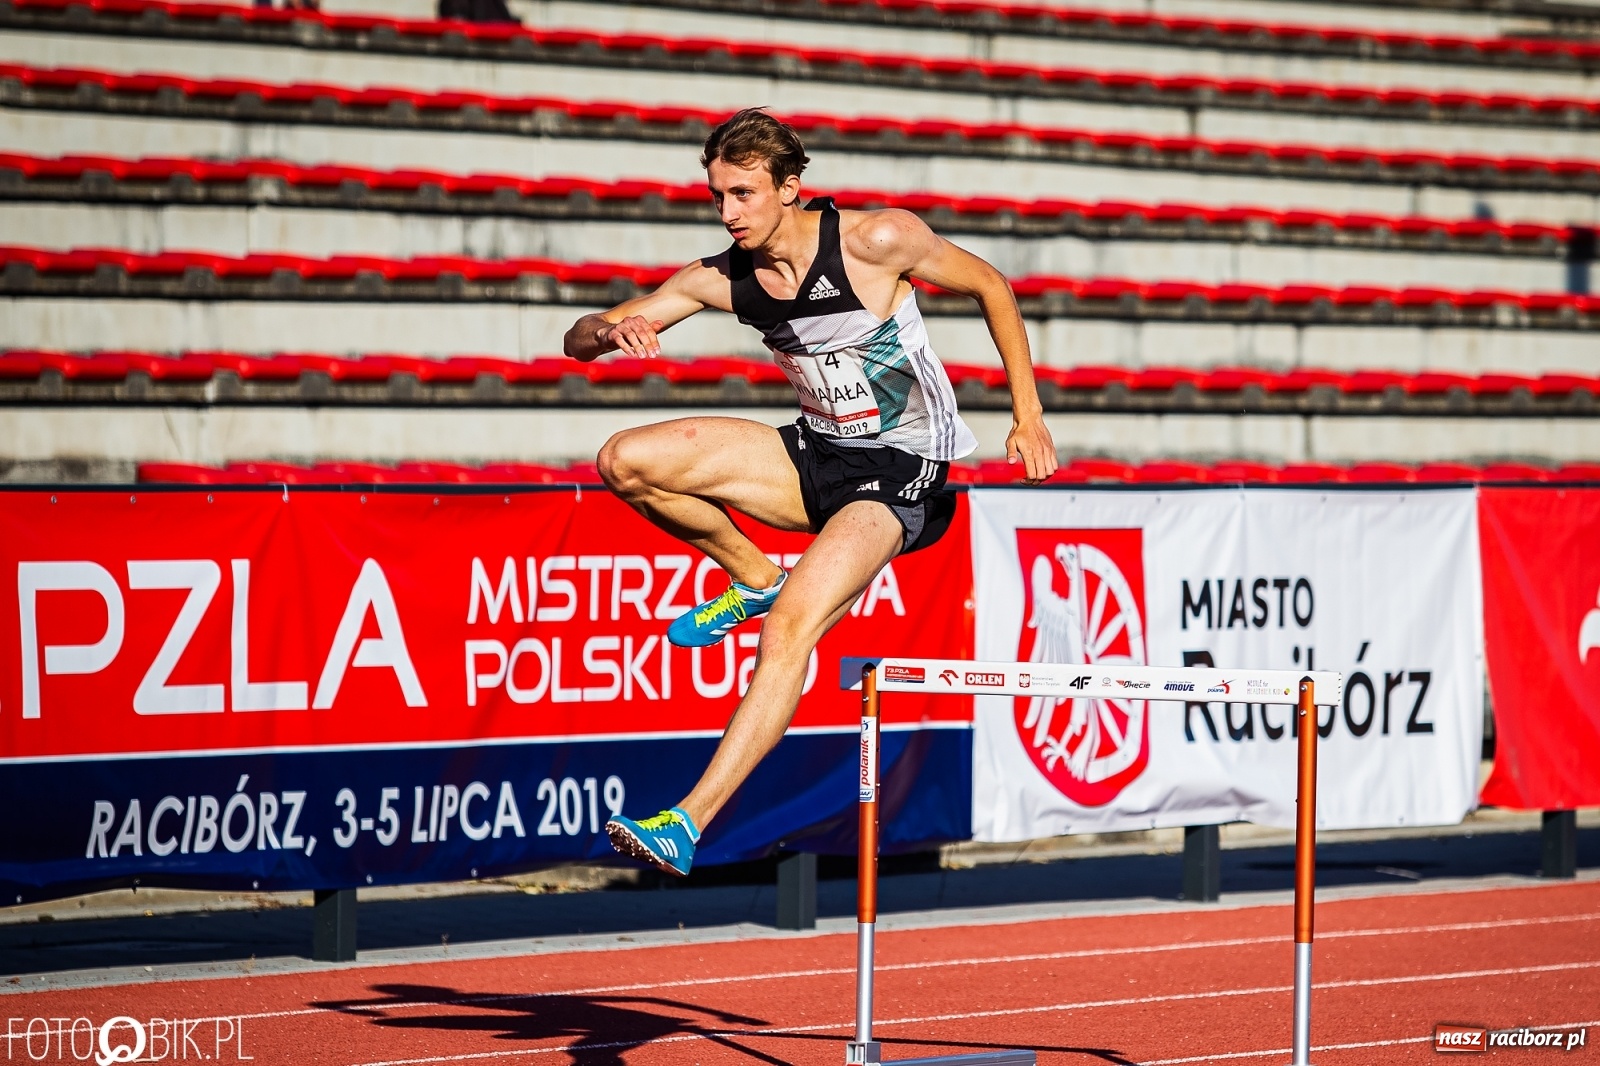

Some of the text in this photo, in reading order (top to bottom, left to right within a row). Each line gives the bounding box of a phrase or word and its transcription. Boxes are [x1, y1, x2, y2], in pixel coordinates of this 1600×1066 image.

[808, 287, 841, 301] adidas
[824, 351, 840, 369] 4
[843, 422, 868, 436] 2019
[467, 554, 907, 625] MISTRZA
[1181, 577, 1315, 630] MIASTO
[18, 557, 429, 719] PZLA
[465, 635, 672, 706] POLSKI
[967, 674, 1003, 686] ORLEN
[1069, 676, 1092, 690] 4F
[1163, 683, 1195, 691] 4MOVE
[861, 738, 870, 786] polanik
[86, 774, 626, 858] RACIBÓRZ, 3-5 LIPCA 2019
